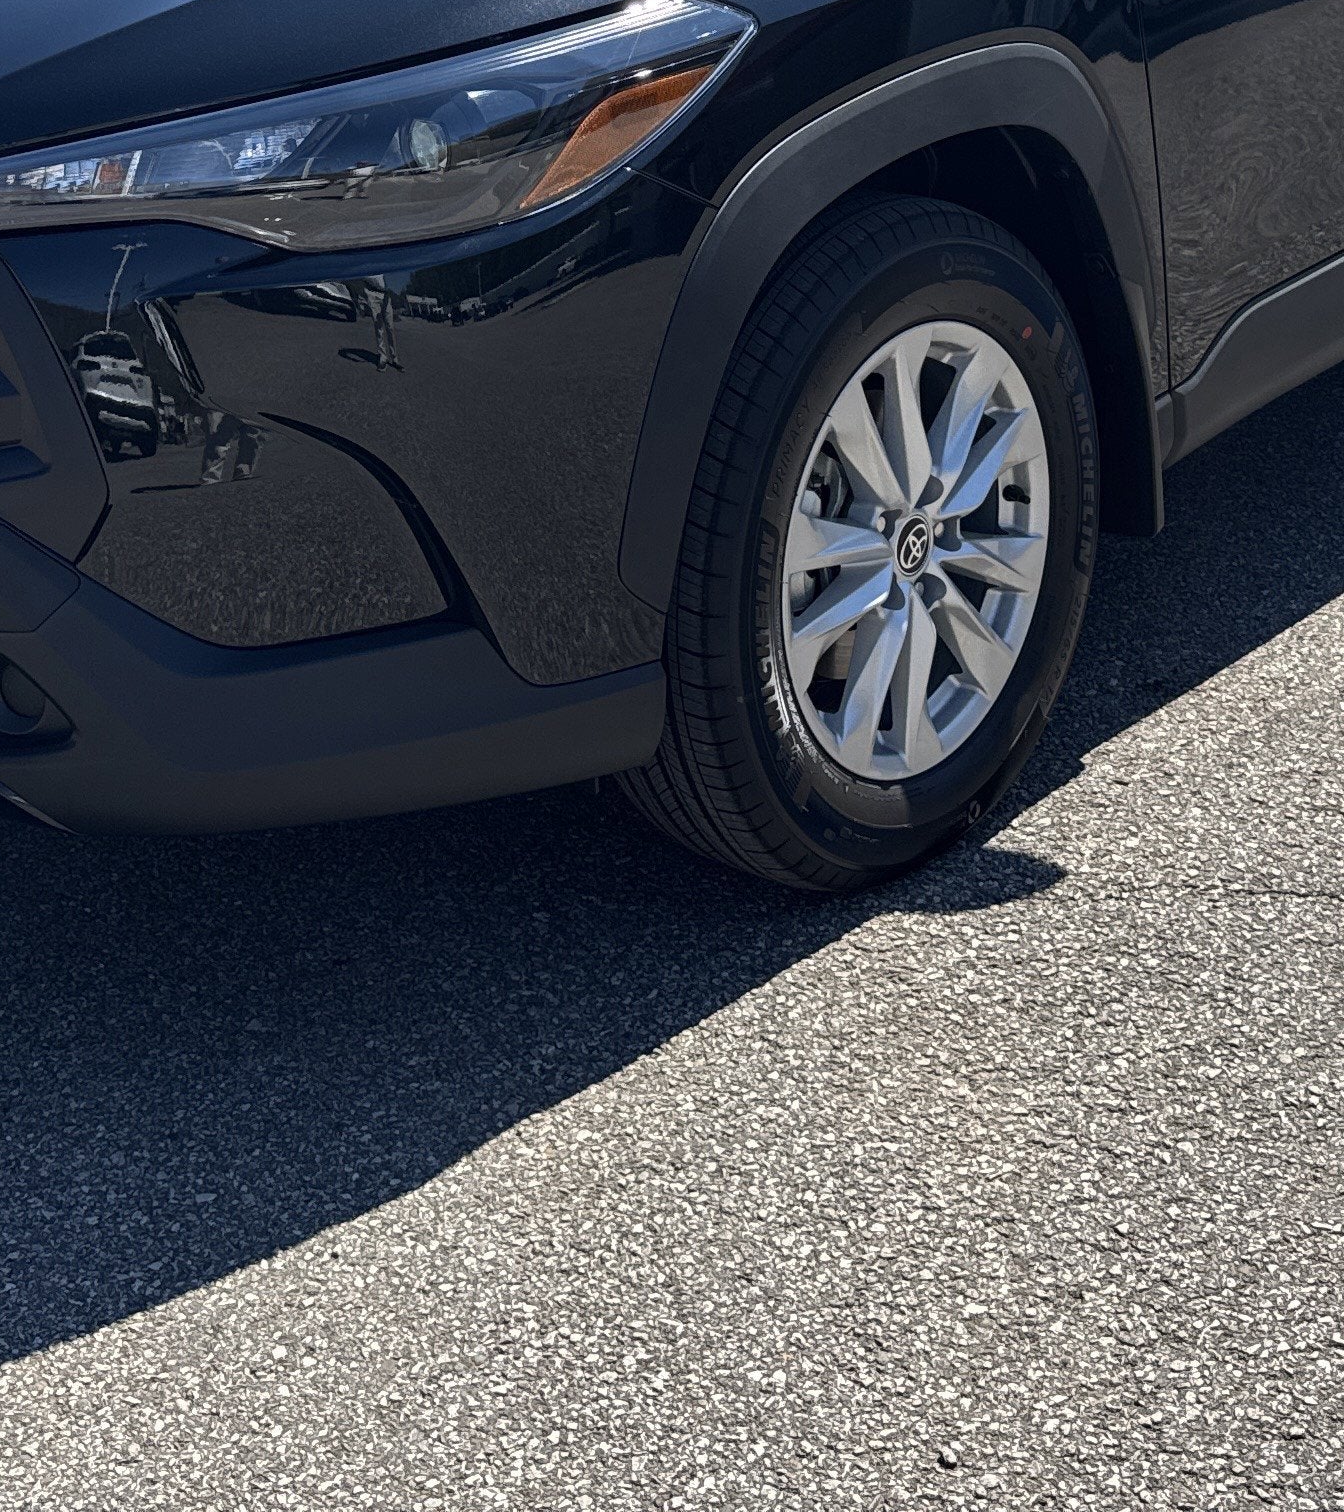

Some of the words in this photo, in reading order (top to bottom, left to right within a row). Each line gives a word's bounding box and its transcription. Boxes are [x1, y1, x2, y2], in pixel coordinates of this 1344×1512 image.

[771, 404, 811, 500] PRIMACY
[1071, 392, 1096, 571] MICHELIN
[754, 530, 784, 733] MICHELIN
